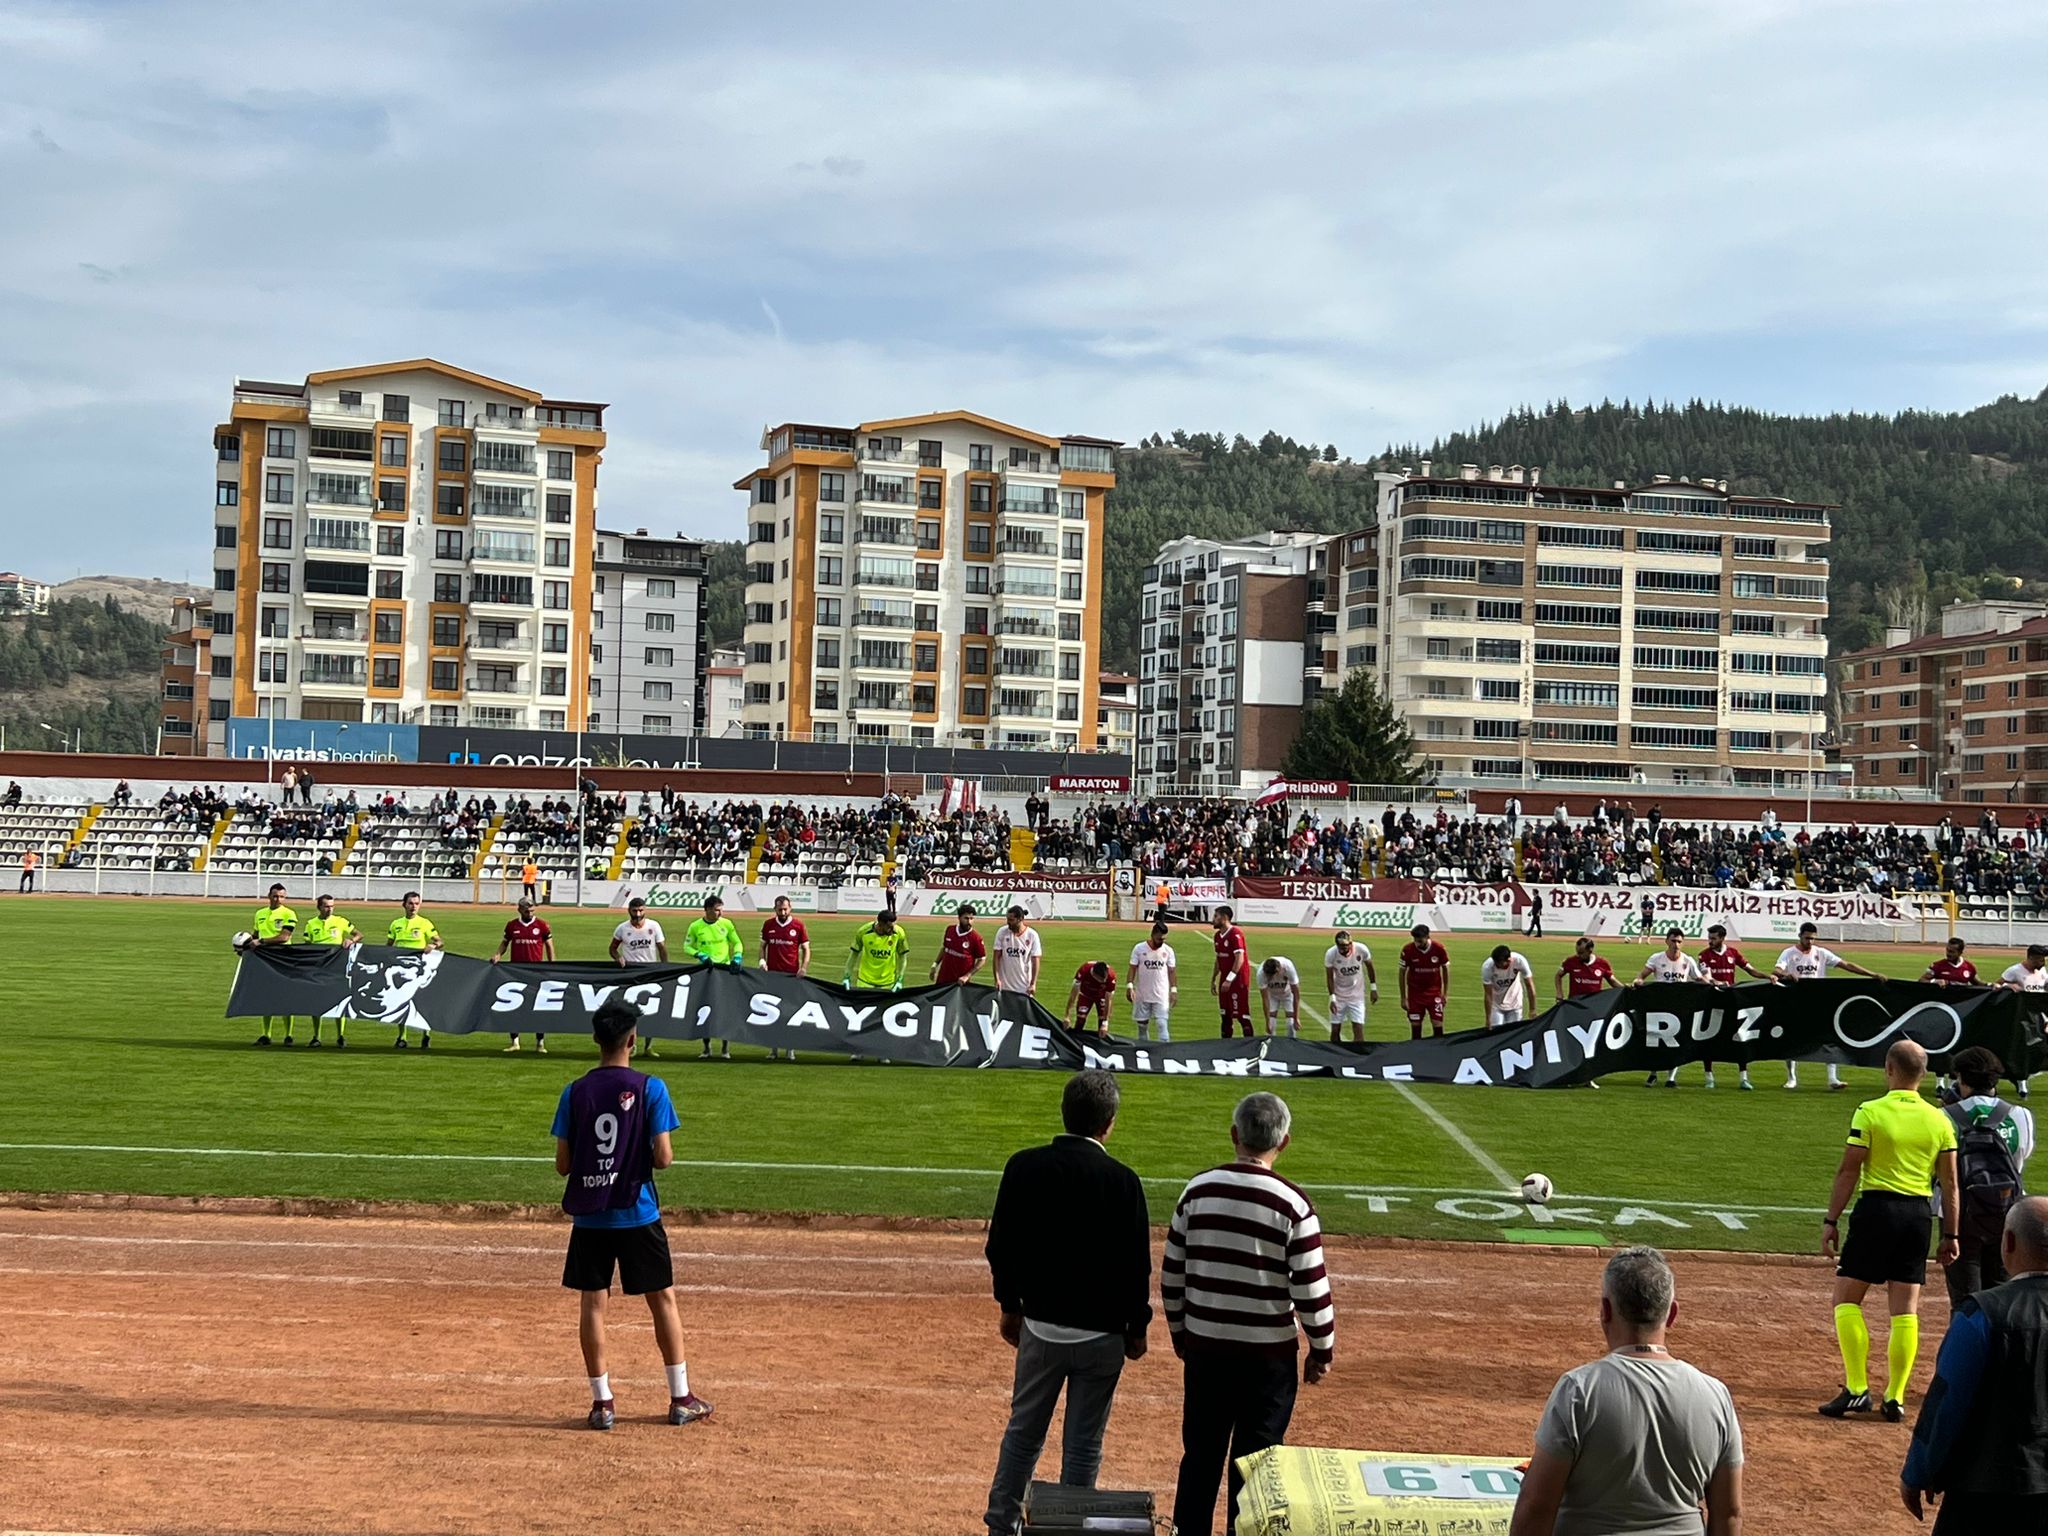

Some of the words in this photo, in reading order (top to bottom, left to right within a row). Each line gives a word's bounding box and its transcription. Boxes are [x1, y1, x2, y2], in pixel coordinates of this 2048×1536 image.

[1059, 778, 1120, 788] MARATON
[1286, 782, 1337, 794] RİBÜNÜ
[927, 874, 1003, 887] YÜRÜYORUZ
[1007, 877, 1107, 891] ŞAMPİYONLUĞA
[1280, 879, 1373, 900] TEŞKİLAT
[1433, 884, 1515, 905] BORDO
[1333, 903, 1414, 928] formül
[630, 939, 651, 947] GKN
[870, 949, 891, 957] GKN
[1144, 959, 1164, 967] GKN
[491, 974, 712, 1025] SEVGİ,
[746, 993, 946, 1042] SAYGI
[976, 1005, 1051, 1061] VE
[1452, 1006, 1784, 1086] ANIYORUZ.
[595, 1113, 618, 1154] 9
[1344, 1193, 1761, 1231] TOKAT
[1383, 1466, 1437, 1491] 6
